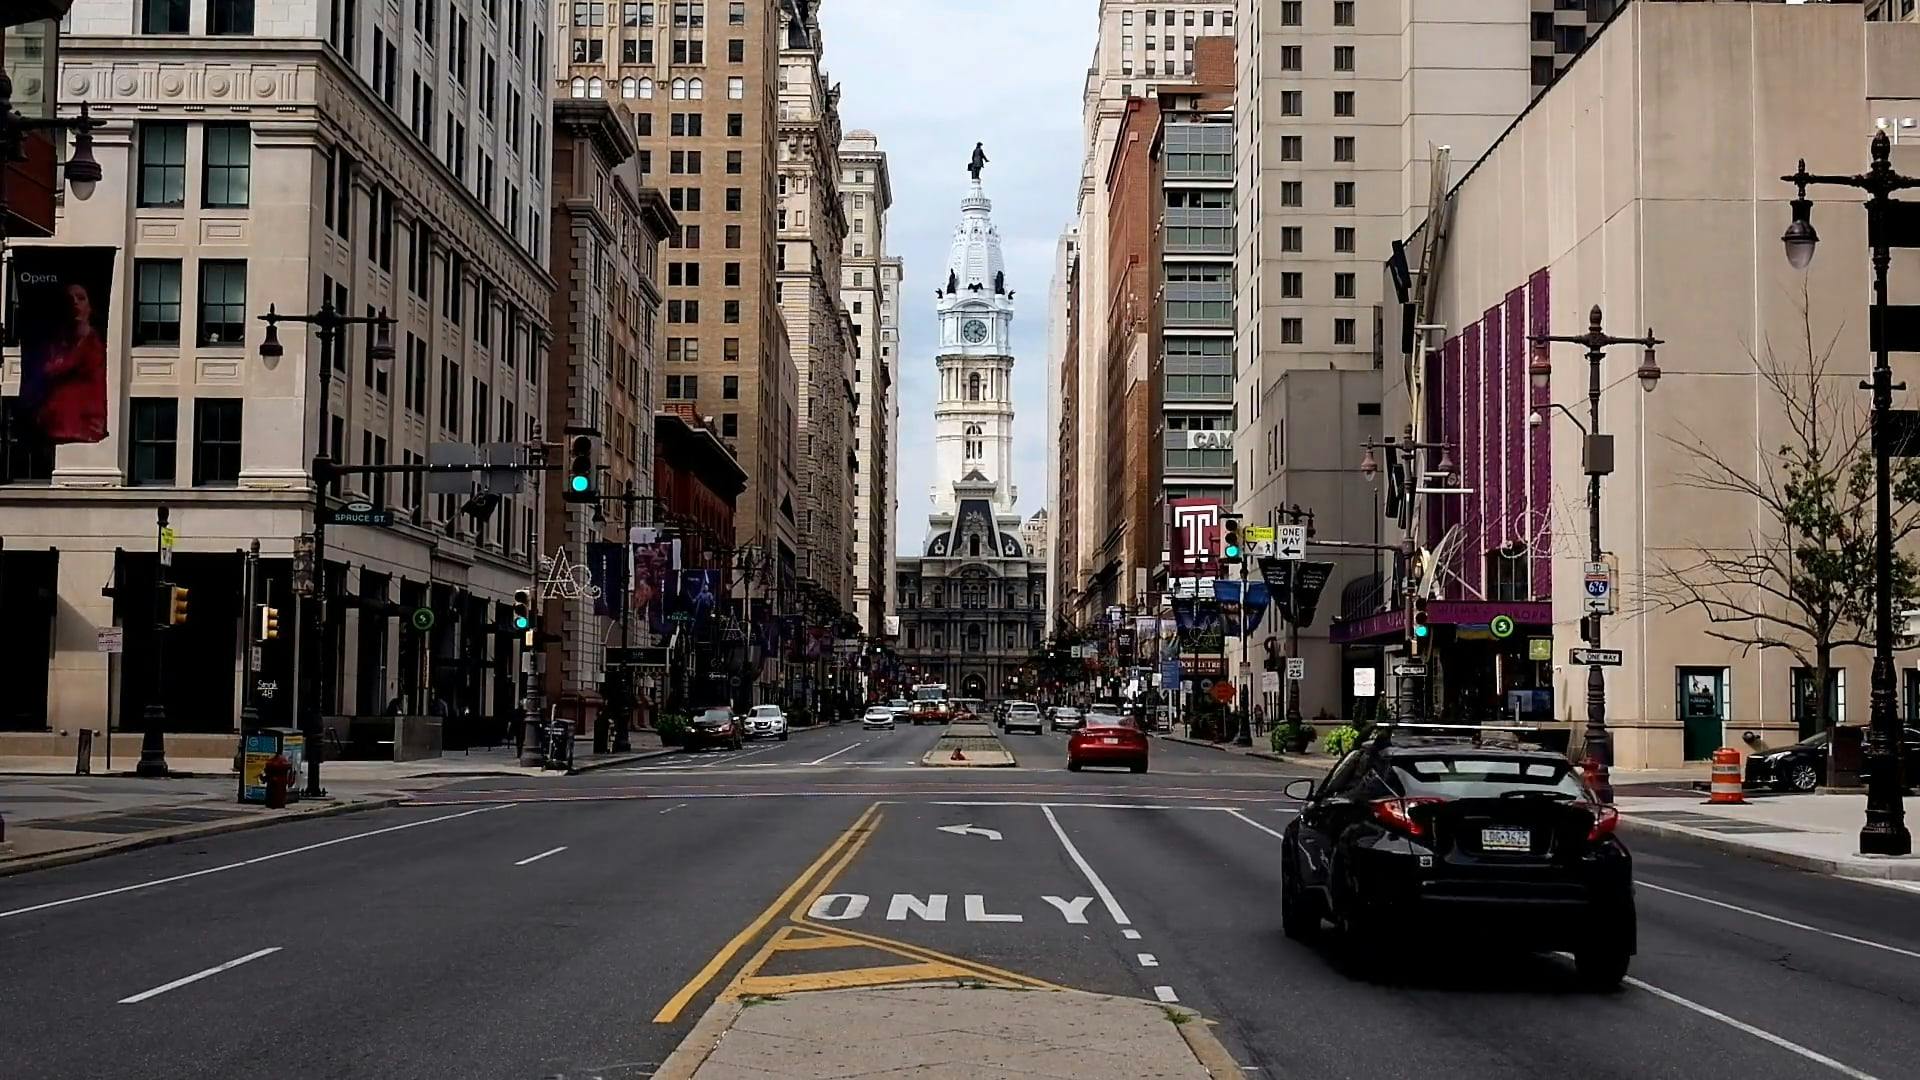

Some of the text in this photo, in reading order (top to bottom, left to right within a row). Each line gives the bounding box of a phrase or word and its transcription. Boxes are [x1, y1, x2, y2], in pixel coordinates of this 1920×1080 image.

[21, 272, 58, 285] Opera
[335, 513, 370, 522] SPRUCE
[1282, 528, 1300, 536] ONE
[1281, 537, 1301, 545] WAY
[1588, 581, 1605, 593] 676
[1289, 670, 1302, 678] 25
[807, 893, 1095, 924] ONLY
